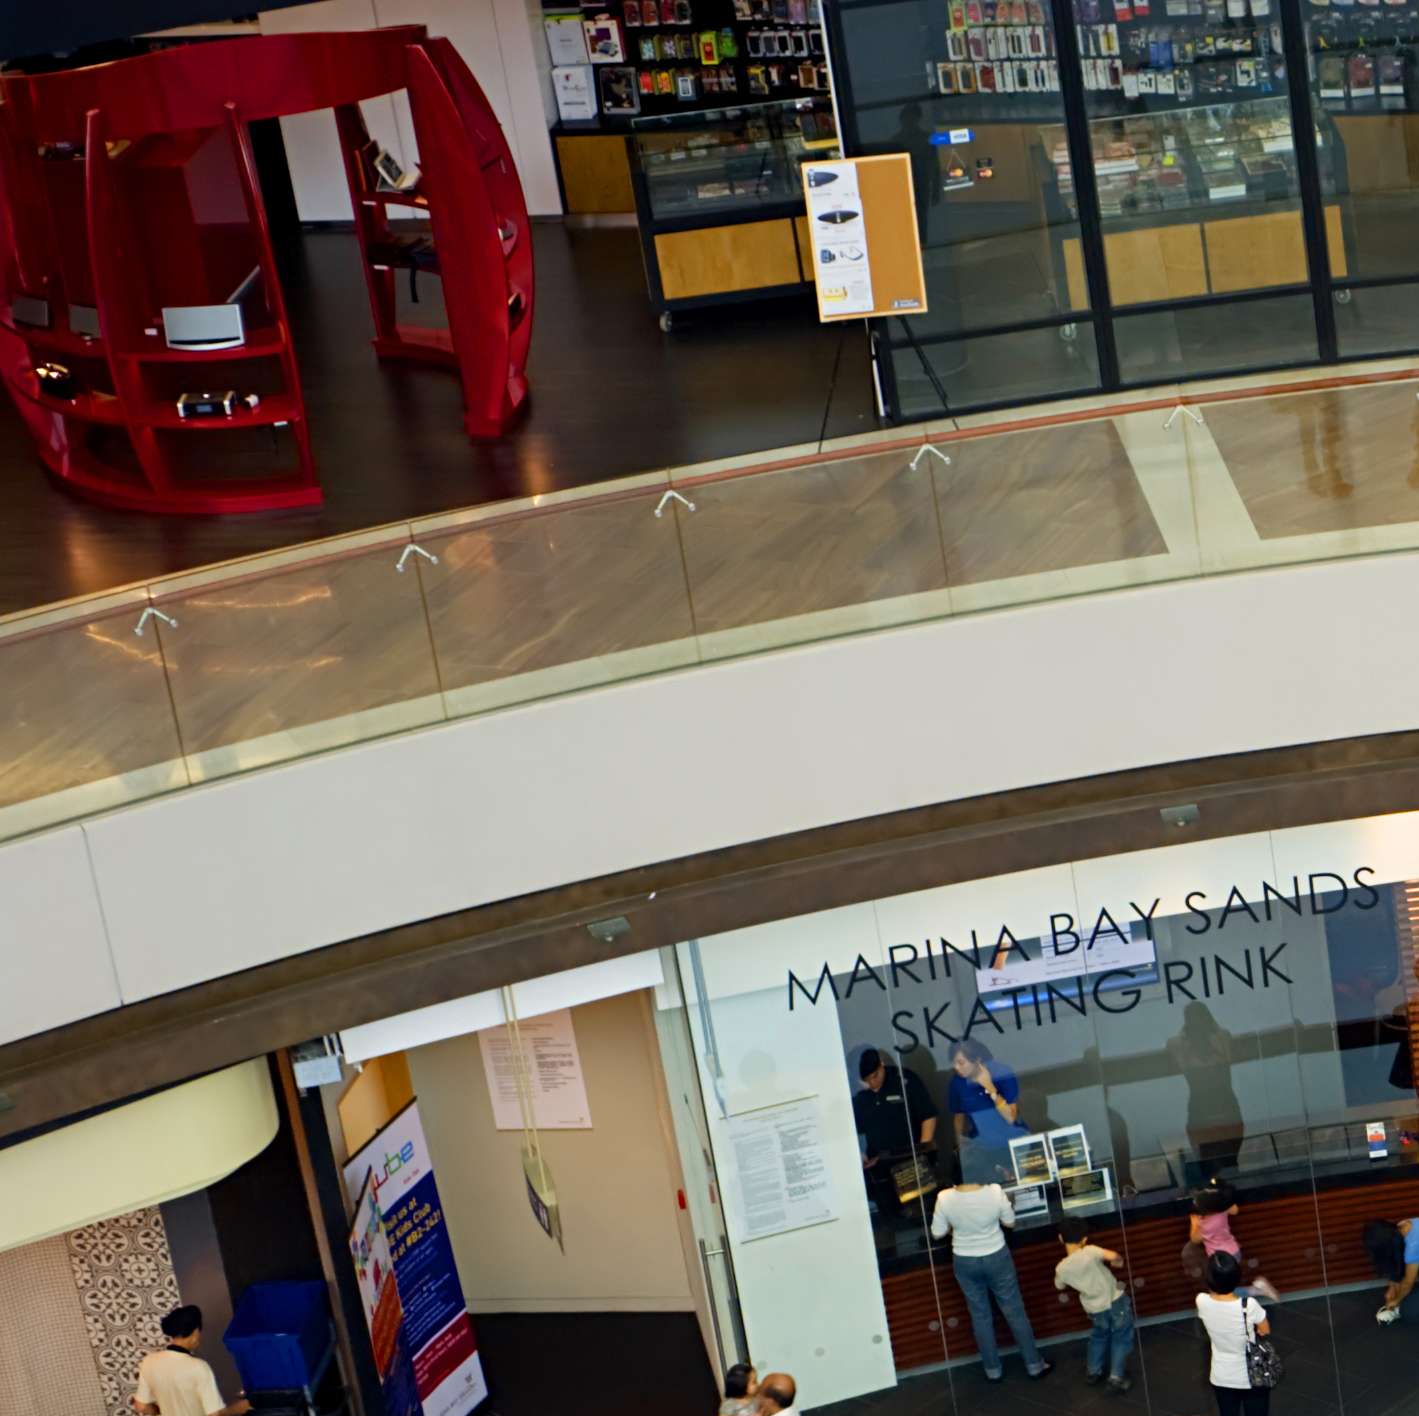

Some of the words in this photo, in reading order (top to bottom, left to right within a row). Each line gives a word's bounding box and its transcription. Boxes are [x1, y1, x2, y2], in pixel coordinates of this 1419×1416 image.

[788, 923, 1031, 1011] MARINA
[1049, 897, 1161, 958] BAY
[1185, 866, 1380, 935] SANDS
[891, 970, 1142, 1055] SKATING
[1165, 942, 1294, 1005] RINK
